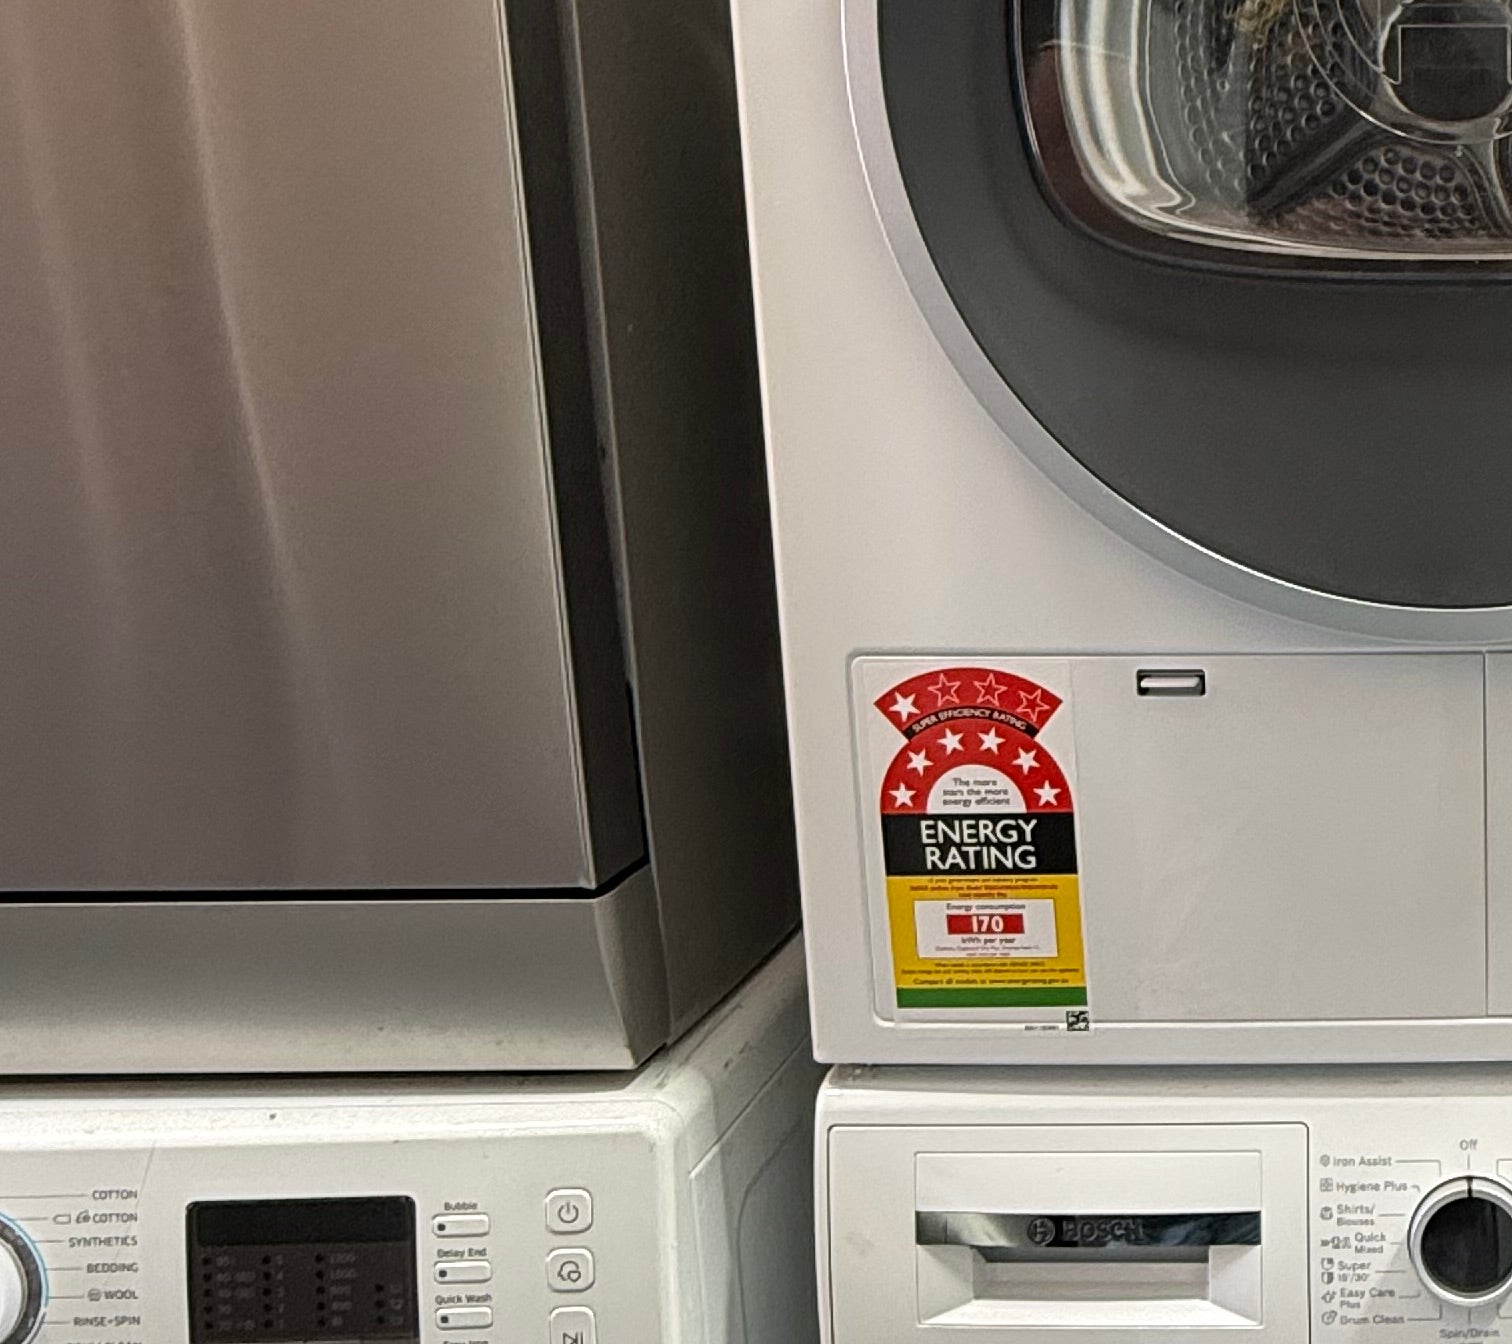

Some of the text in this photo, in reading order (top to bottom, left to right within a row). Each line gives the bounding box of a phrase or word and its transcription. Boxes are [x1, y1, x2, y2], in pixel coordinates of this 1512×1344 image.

[912, 712, 938, 733] SUPER
[919, 817, 1038, 846] ENERGY
[924, 845, 1038, 871] RATING
[971, 915, 1005, 934] 170
[1459, 1138, 1478, 1151] Off
[1358, 1156, 1393, 1167] Assist
[1384, 1180, 1408, 1192] Plus
[92, 1189, 138, 1201] COTTON
[92, 1212, 138, 1224] COTTON
[1062, 1219, 1146, 1241] BOSCH
[68, 1235, 138, 1248] SYNTHETICS
[86, 1263, 139, 1273] BEDDING
[1337, 1260, 1372, 1271] Super
[104, 1289, 139, 1300] WOOL
[1340, 1287, 1396, 1300] Easy Care
